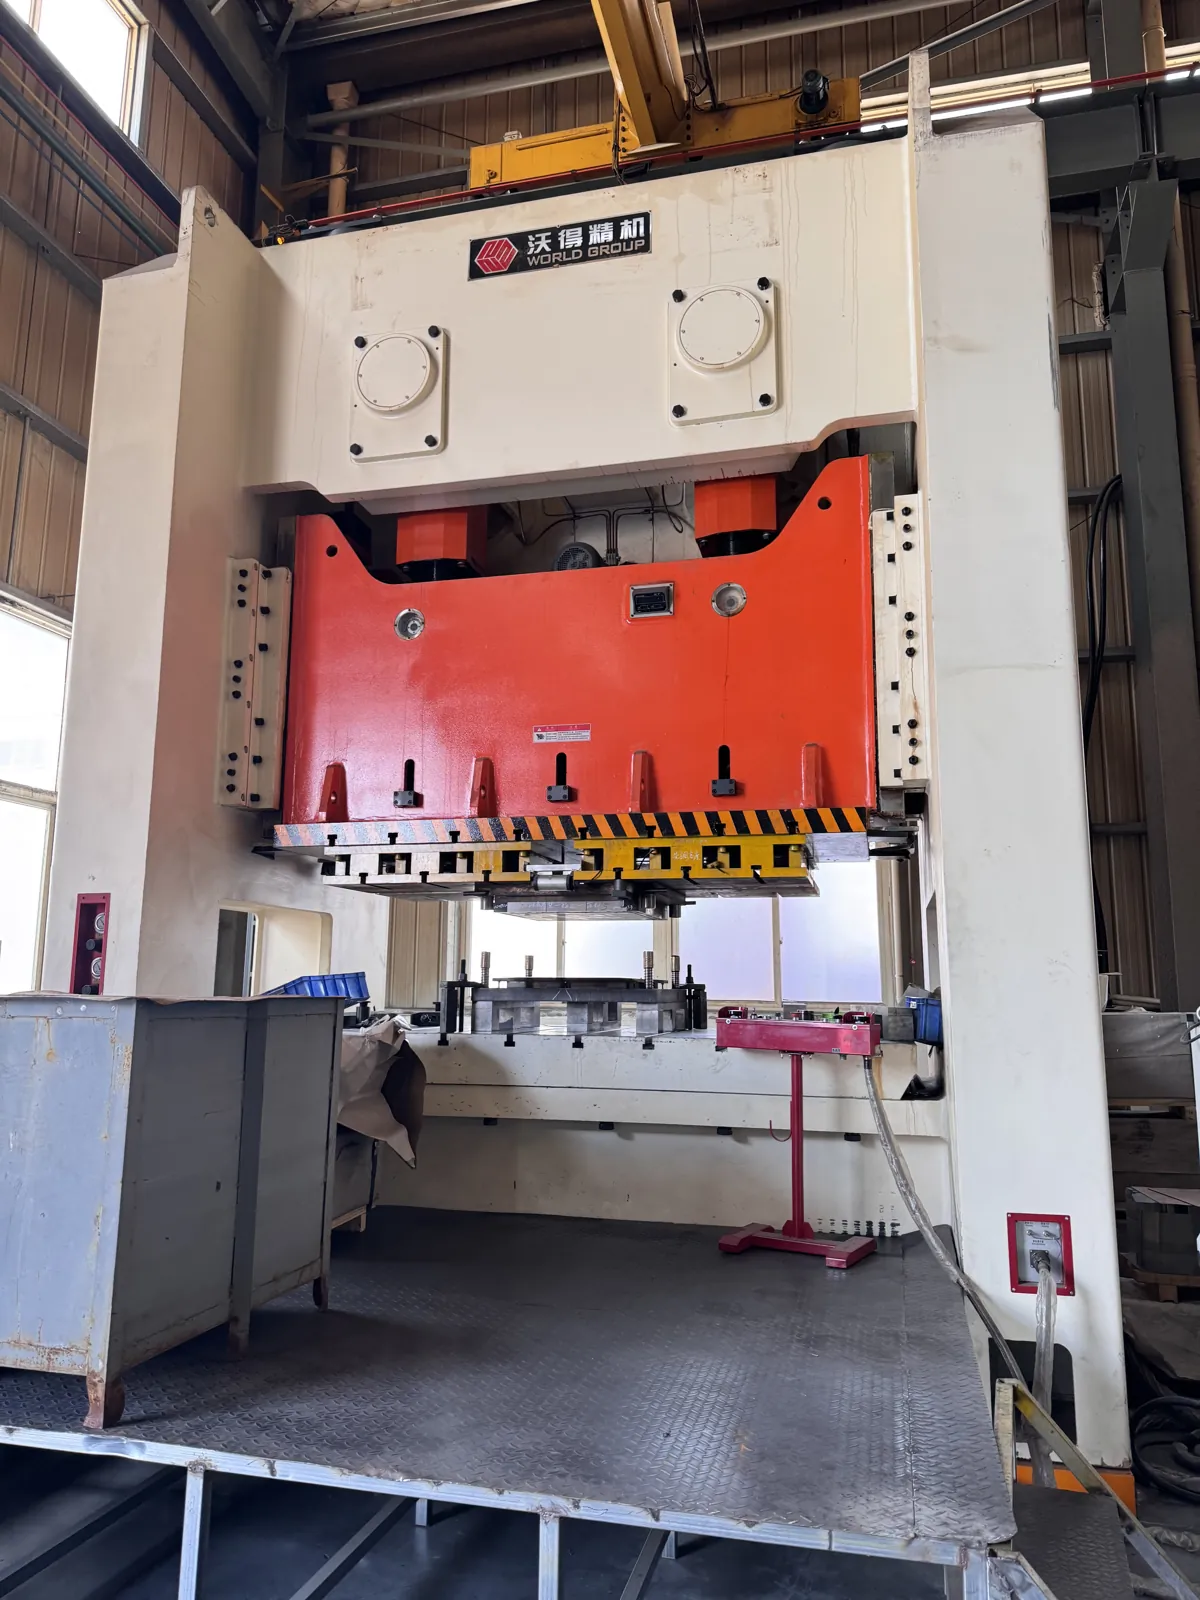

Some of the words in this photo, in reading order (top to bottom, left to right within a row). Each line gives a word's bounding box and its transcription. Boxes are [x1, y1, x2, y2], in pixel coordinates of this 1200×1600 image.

[527, 217, 645, 255] 沃得精机
[527, 250, 582, 267] WORLD
[588, 239, 645, 257] GROUP
